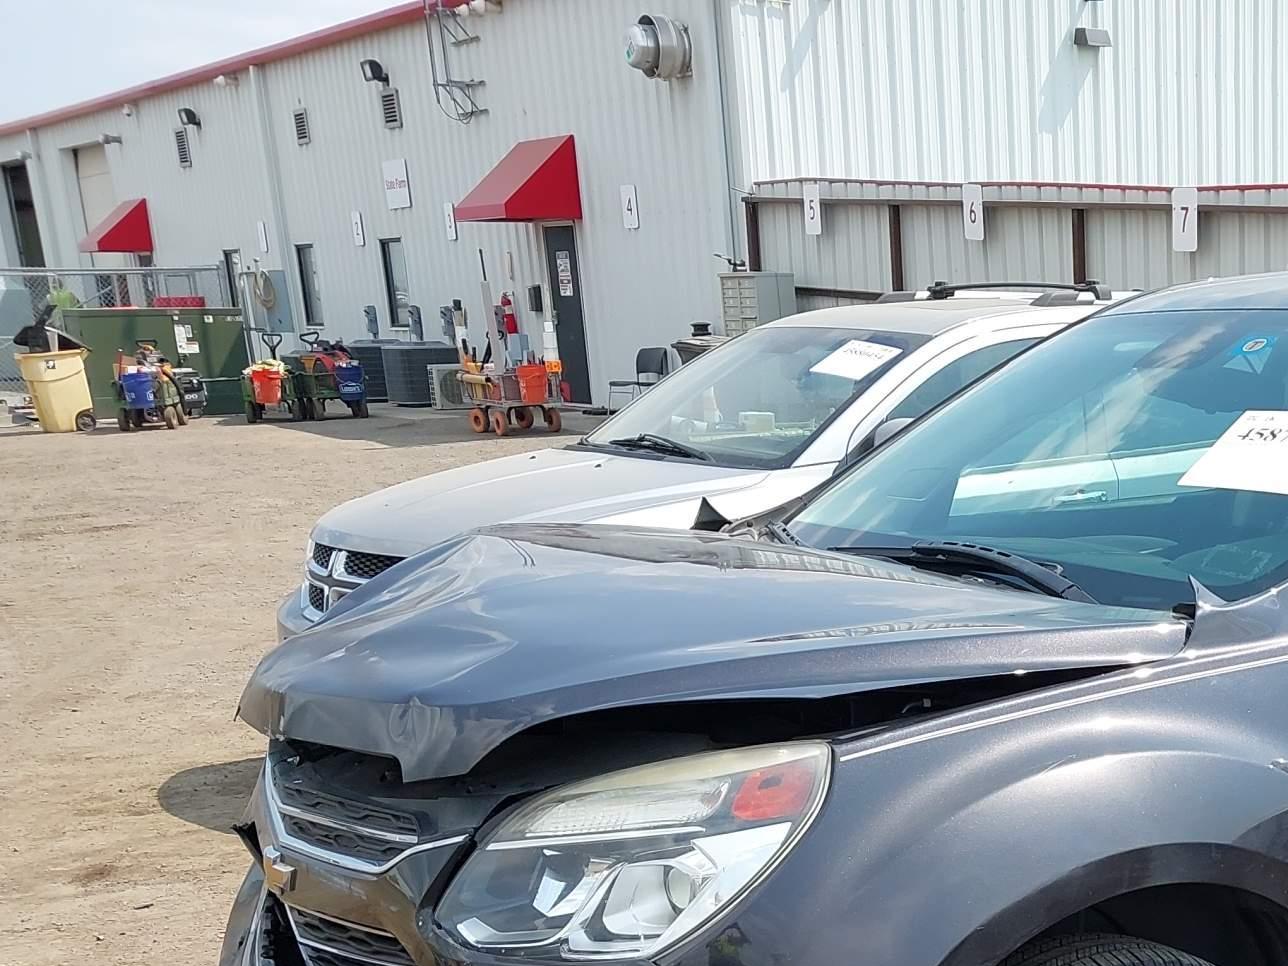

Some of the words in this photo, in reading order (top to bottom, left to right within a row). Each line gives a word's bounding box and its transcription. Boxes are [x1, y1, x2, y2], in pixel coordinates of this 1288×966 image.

[626, 197, 633, 216] 4
[808, 199, 816, 220] 5
[969, 201, 977, 224] 6
[1180, 206, 1190, 233] 7
